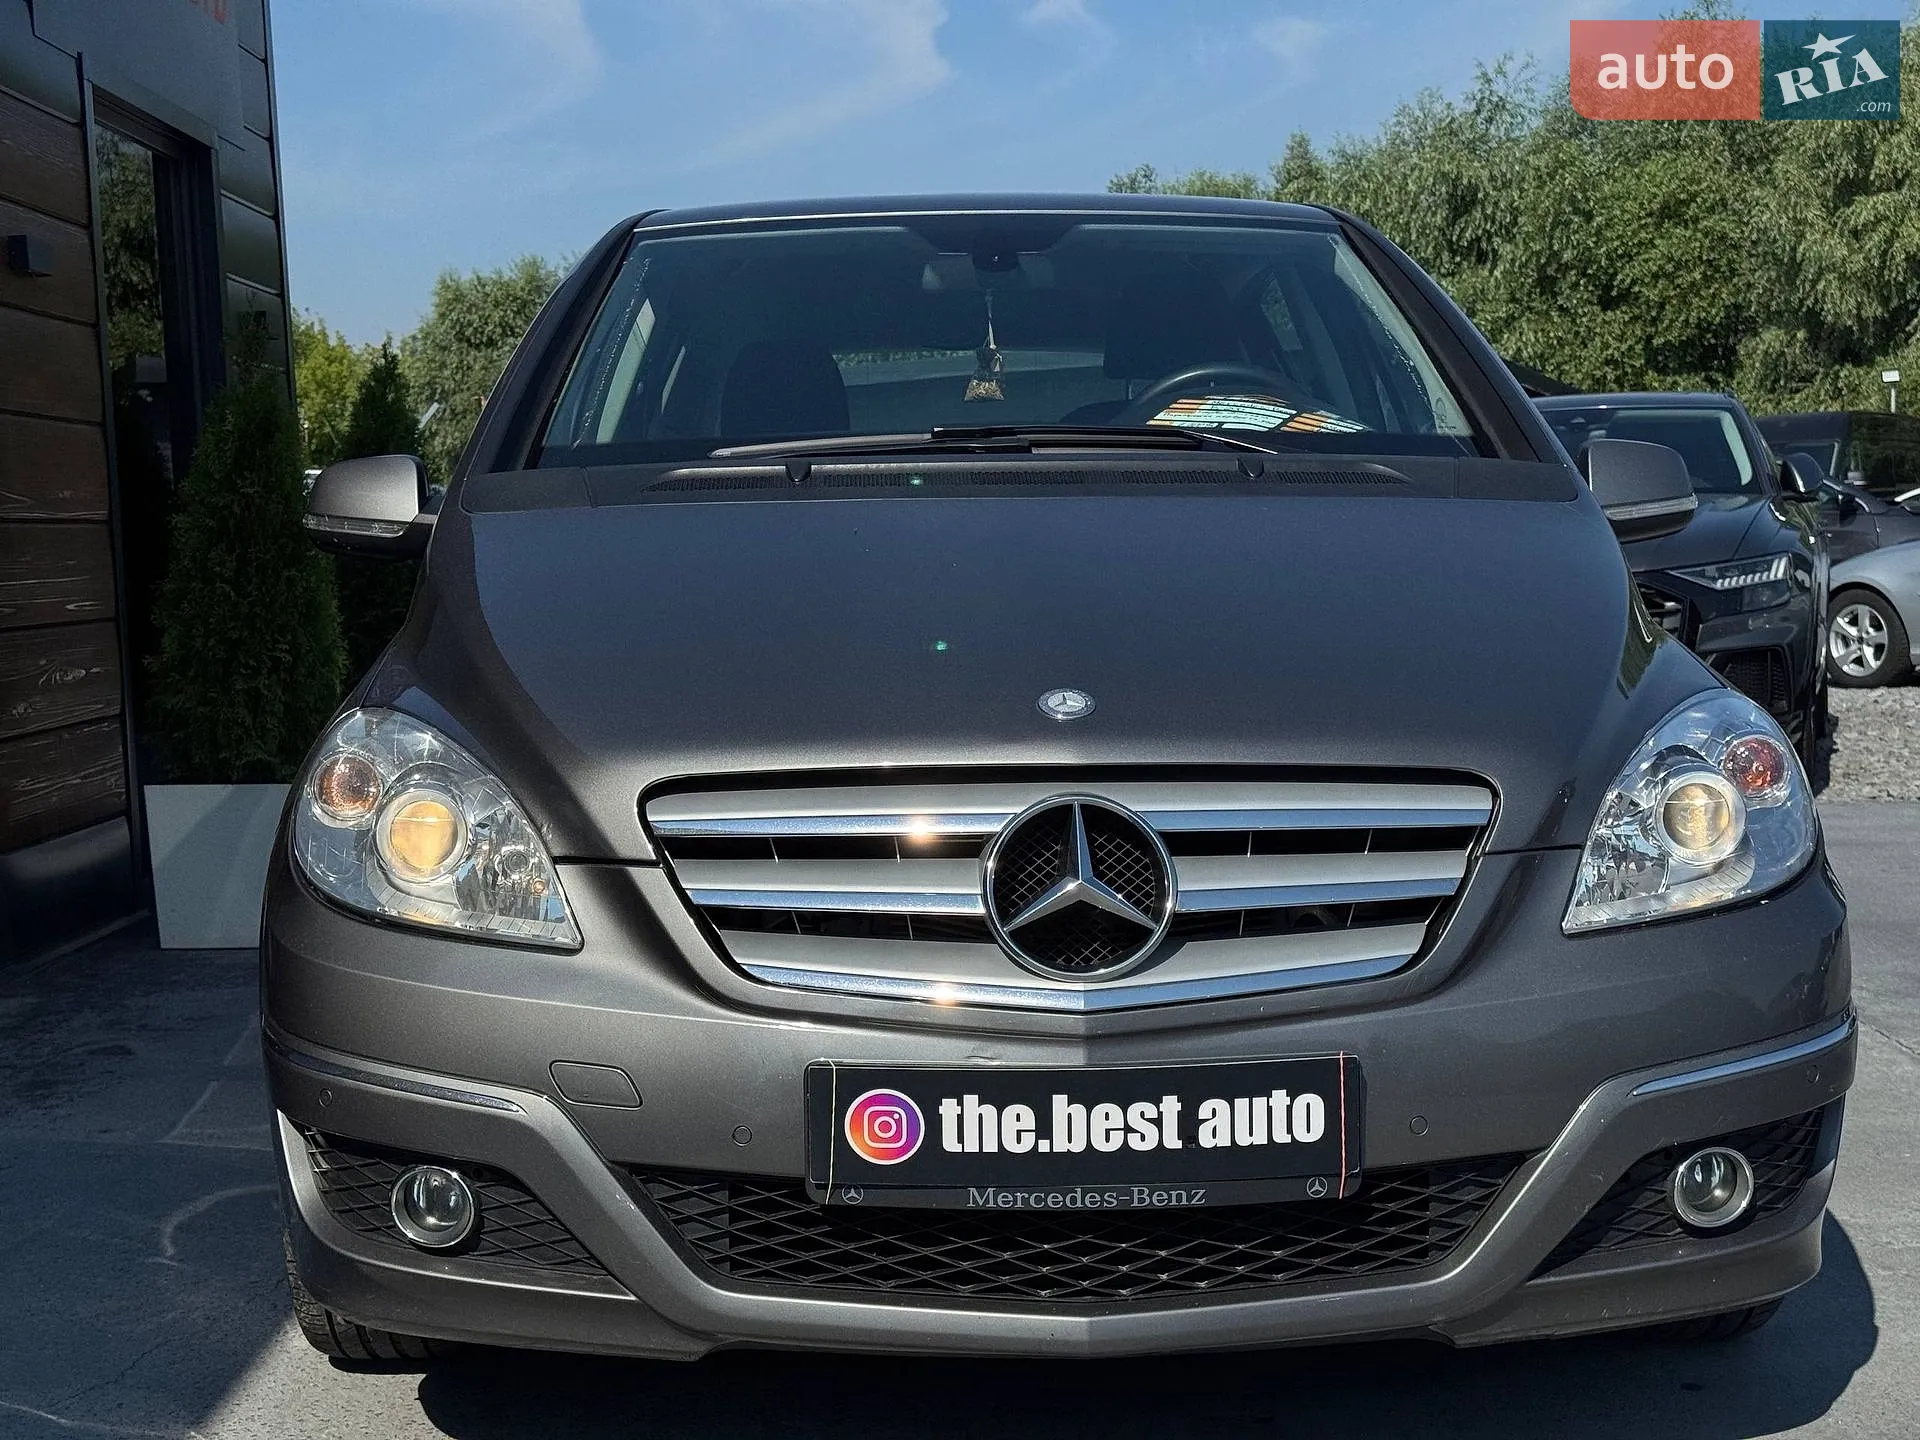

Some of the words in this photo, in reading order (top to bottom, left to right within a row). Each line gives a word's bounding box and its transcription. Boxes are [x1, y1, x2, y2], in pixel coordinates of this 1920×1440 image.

[939, 1093, 1183, 1153] the.best
[1197, 1089, 1326, 1149] auto
[966, 1187, 1206, 1209] Mercedes-Benz
